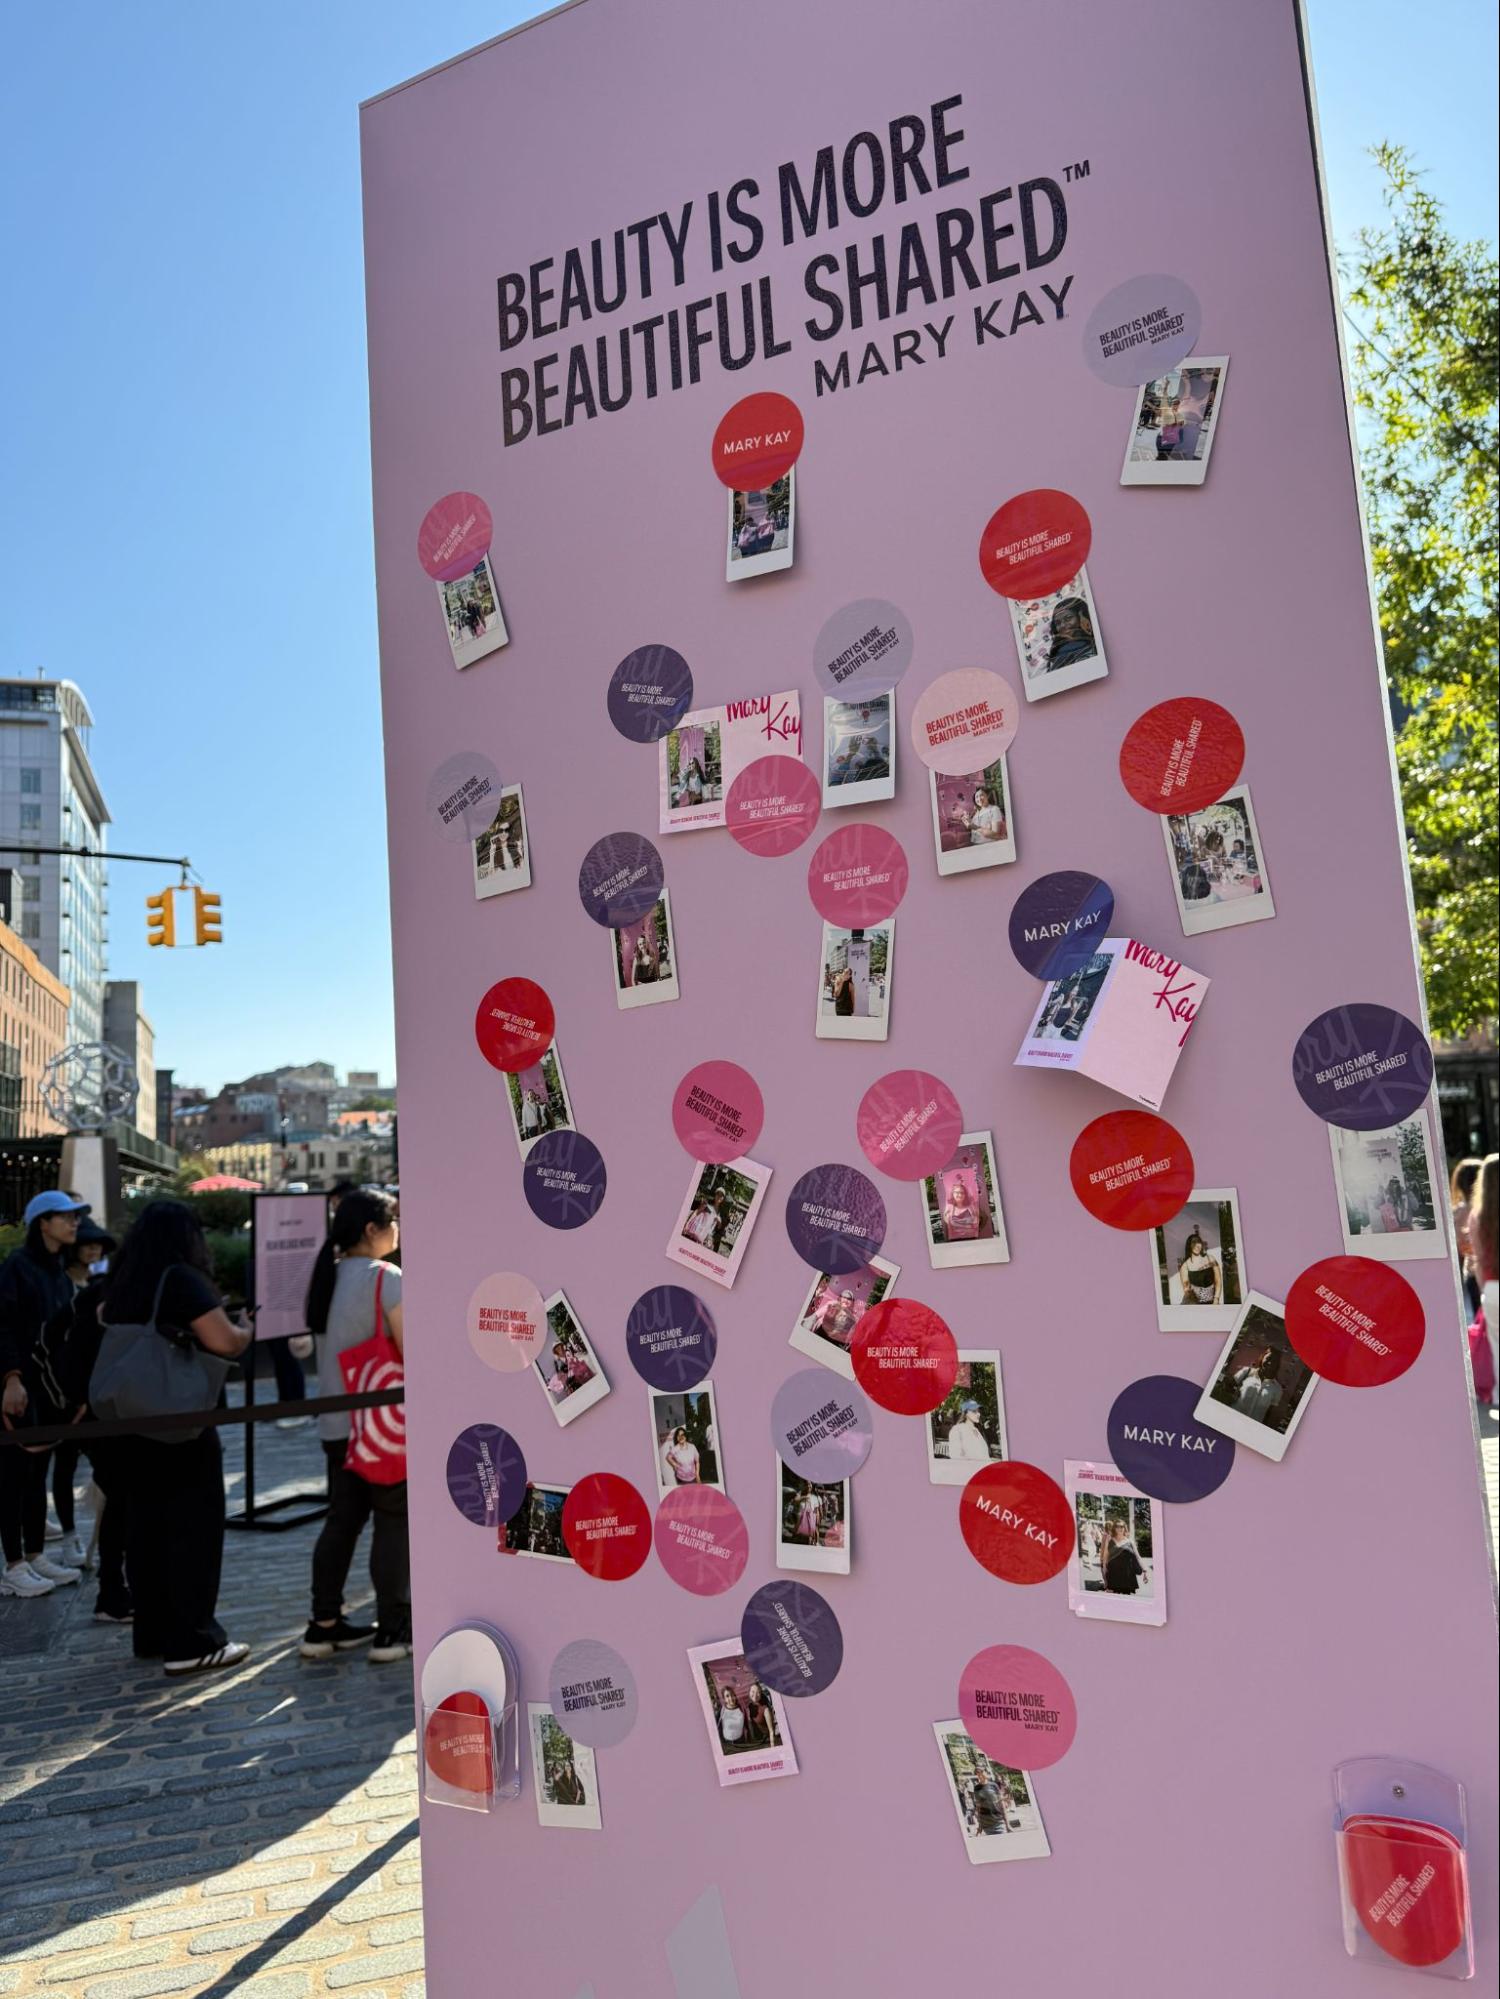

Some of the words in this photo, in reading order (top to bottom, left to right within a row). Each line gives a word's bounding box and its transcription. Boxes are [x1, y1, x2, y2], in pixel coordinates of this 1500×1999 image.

[497, 200, 693, 352] BEAUTY
[707, 178, 764, 273] IS
[778, 93, 970, 246] MORE
[814, 315, 955, 397] MARY
[973, 275, 1075, 345] KAY
[1100, 323, 1132, 346] BEAUTY
[1131, 318, 1143, 332] IS
[1142, 307, 1169, 327] MORE
[1102, 331, 1148, 358] BEAUTIFUL
[501, 275, 792, 447] BEAUTIFUL
[724, 437, 761, 454] MARY
[765, 430, 791, 446] KAY
[996, 542, 1020, 559] BEAUTY
[1020, 538, 1029, 550] IS
[1029, 530, 1049, 546] MORE
[1009, 543, 1044, 565] BEAUTIFUL
[828, 647, 854, 674] BEAUTY
[852, 641, 862, 655] IS
[860, 626, 882, 648] MORE
[834, 650, 870, 683] BEAUTIFUL
[926, 714, 955, 734] BEAUTY
[954, 710, 965, 723] IS
[965, 701, 989, 719] MORE
[929, 722, 971, 746] BEAUTIFUL
[1170, 739, 1184, 762] MORE
[1167, 760, 1178, 771] IS
[1175, 749, 1194, 787] BEAUTIFUL
[1161, 770, 1175, 797] BEAUTY
[1024, 921, 1069, 942] MARY
[1075, 910, 1101, 930] KAY
[1315, 1064, 1344, 1084] BEAUTY
[1344, 1060, 1354, 1073] IS
[1354, 1050, 1378, 1069] MORE
[1333, 1066, 1375, 1090] BEAUTIFUL
[686, 1096, 720, 1123] BEAUTIFUL
[691, 1086, 715, 1106] BEAUTY
[713, 1098, 723, 1111] IS
[722, 1103, 742, 1121] MORE
[1089, 1166, 1115, 1184] BEAUTY
[1114, 1162, 1124, 1175] IS
[1123, 1155, 1145, 1172] MORE
[1105, 1169, 1142, 1191] BEAUTIFUL
[802, 1202, 824, 1215] BEAUTY
[824, 1207, 832, 1217] IS
[832, 1209, 850, 1222] MORE
[810, 1216, 841, 1231] BEAUTIFUL
[480, 1308, 500, 1320] BEAUTY
[501, 1309, 508, 1320] IS
[509, 1310, 527, 1321] MORE
[1315, 1284, 1345, 1309] BEAUTY
[1342, 1302, 1355, 1316] IS
[1352, 1309, 1376, 1330] MORE
[1319, 1304, 1359, 1336] BEAUTIFUL
[479, 1321, 510, 1332] BEAUTIFUL
[868, 1347, 890, 1357] BEAUTY
[891, 1347, 898, 1357] IS
[900, 1347, 918, 1357] MORE
[880, 1359, 912, 1368] BEAUTIFUL
[787, 1419, 812, 1445] BEAUTY
[810, 1414, 821, 1428] IS
[818, 1400, 839, 1422] MORE
[792, 1425, 829, 1456] BEAUTIFUL
[1124, 1425, 1176, 1446] MARY
[1182, 1434, 1216, 1453] KAY
[976, 1496, 1023, 1528] MARY
[1025, 1523, 1058, 1549] KAY
[561, 1684, 585, 1698] BEAUTY
[585, 1682, 593, 1693] IS
[593, 1678, 613, 1692] MORE
[975, 1690, 1006, 1705] BEAUTY
[1007, 1692, 1018, 1705] IS
[1019, 1693, 1044, 1707] MORE
[564, 1695, 598, 1711] BEAUTIFUL
[977, 1706, 1021, 1721] BEAUTIFUL
